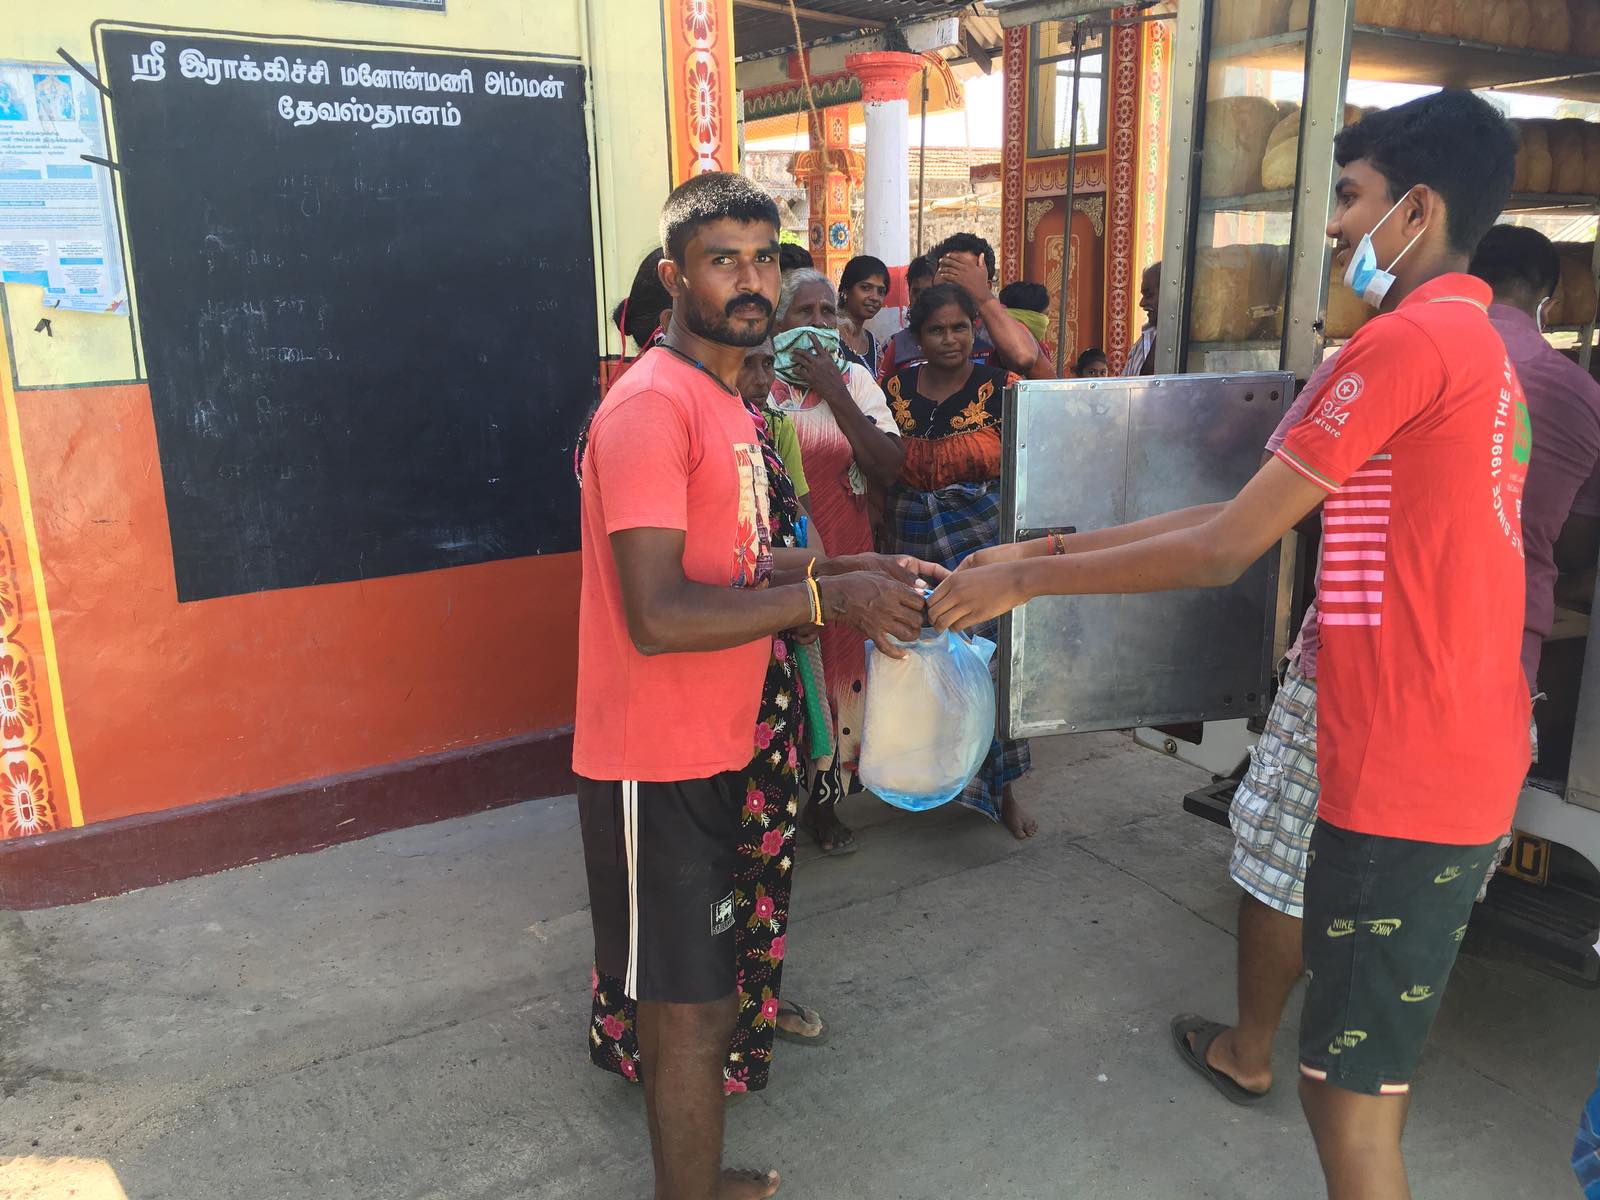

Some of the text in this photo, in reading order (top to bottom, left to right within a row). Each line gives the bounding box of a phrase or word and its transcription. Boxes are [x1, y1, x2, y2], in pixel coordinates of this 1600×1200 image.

[179, 48, 330, 85] இராக்கிச்சி
[340, 63, 474, 94] மனோன்மணி
[484, 71, 565, 99] அம்மன்
[278, 95, 461, 130] தேவஸ்தானம்
[1494, 387, 1511, 428] THE
[1491, 433, 1504, 478] 1996
[1492, 482, 1511, 536] SINCE
[1332, 918, 1355, 930] NIKE
[1370, 923, 1393, 937] NIKE
[1410, 984, 1430, 996] NIKE
